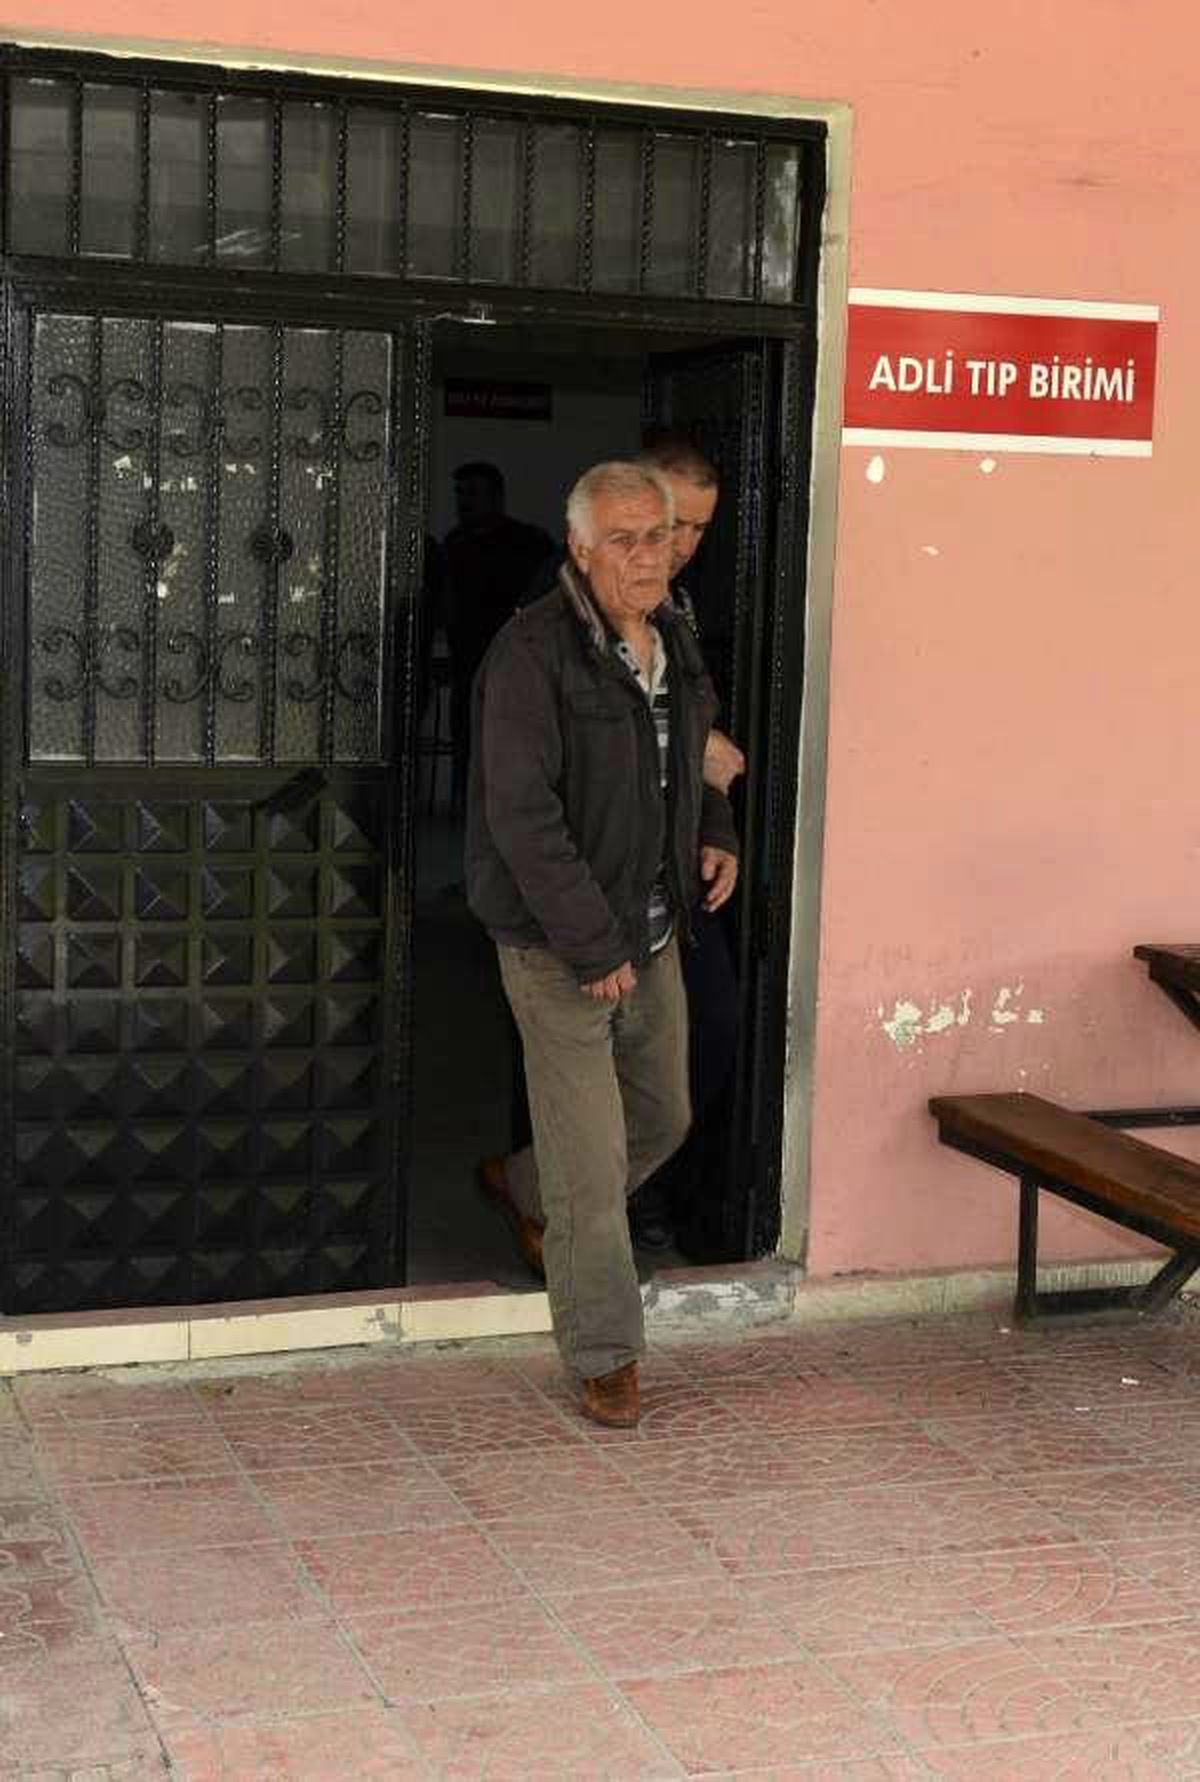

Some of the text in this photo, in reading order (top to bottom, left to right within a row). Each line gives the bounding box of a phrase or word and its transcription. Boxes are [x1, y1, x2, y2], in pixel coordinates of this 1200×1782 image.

[868, 349, 1136, 403] ADLİ TIP BİRİMİ
